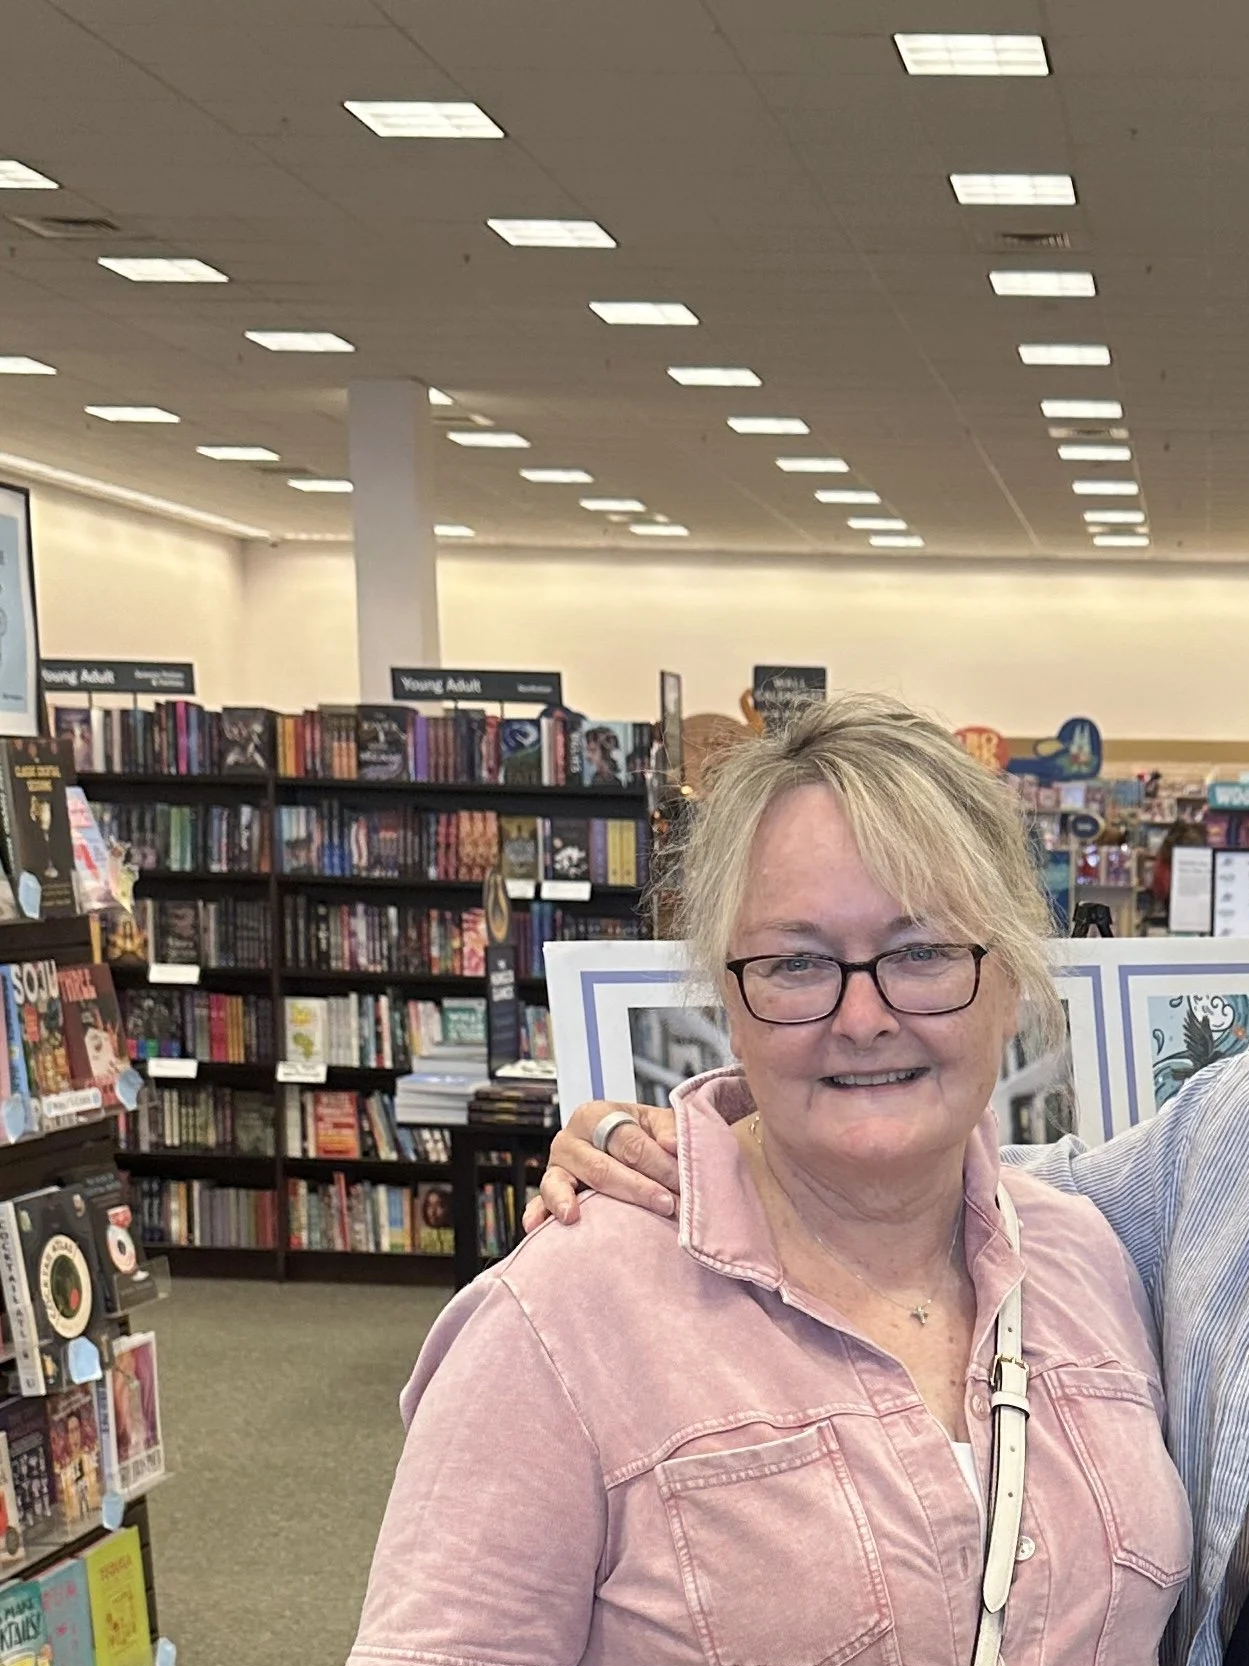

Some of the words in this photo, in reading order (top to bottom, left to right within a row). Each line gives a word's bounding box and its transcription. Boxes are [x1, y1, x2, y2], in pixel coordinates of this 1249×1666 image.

[401, 676, 444, 695] Young
[446, 677, 482, 694] Adult
[11, 959, 59, 1005] SOJU
[5, 1597, 34, 1616] MAKE
